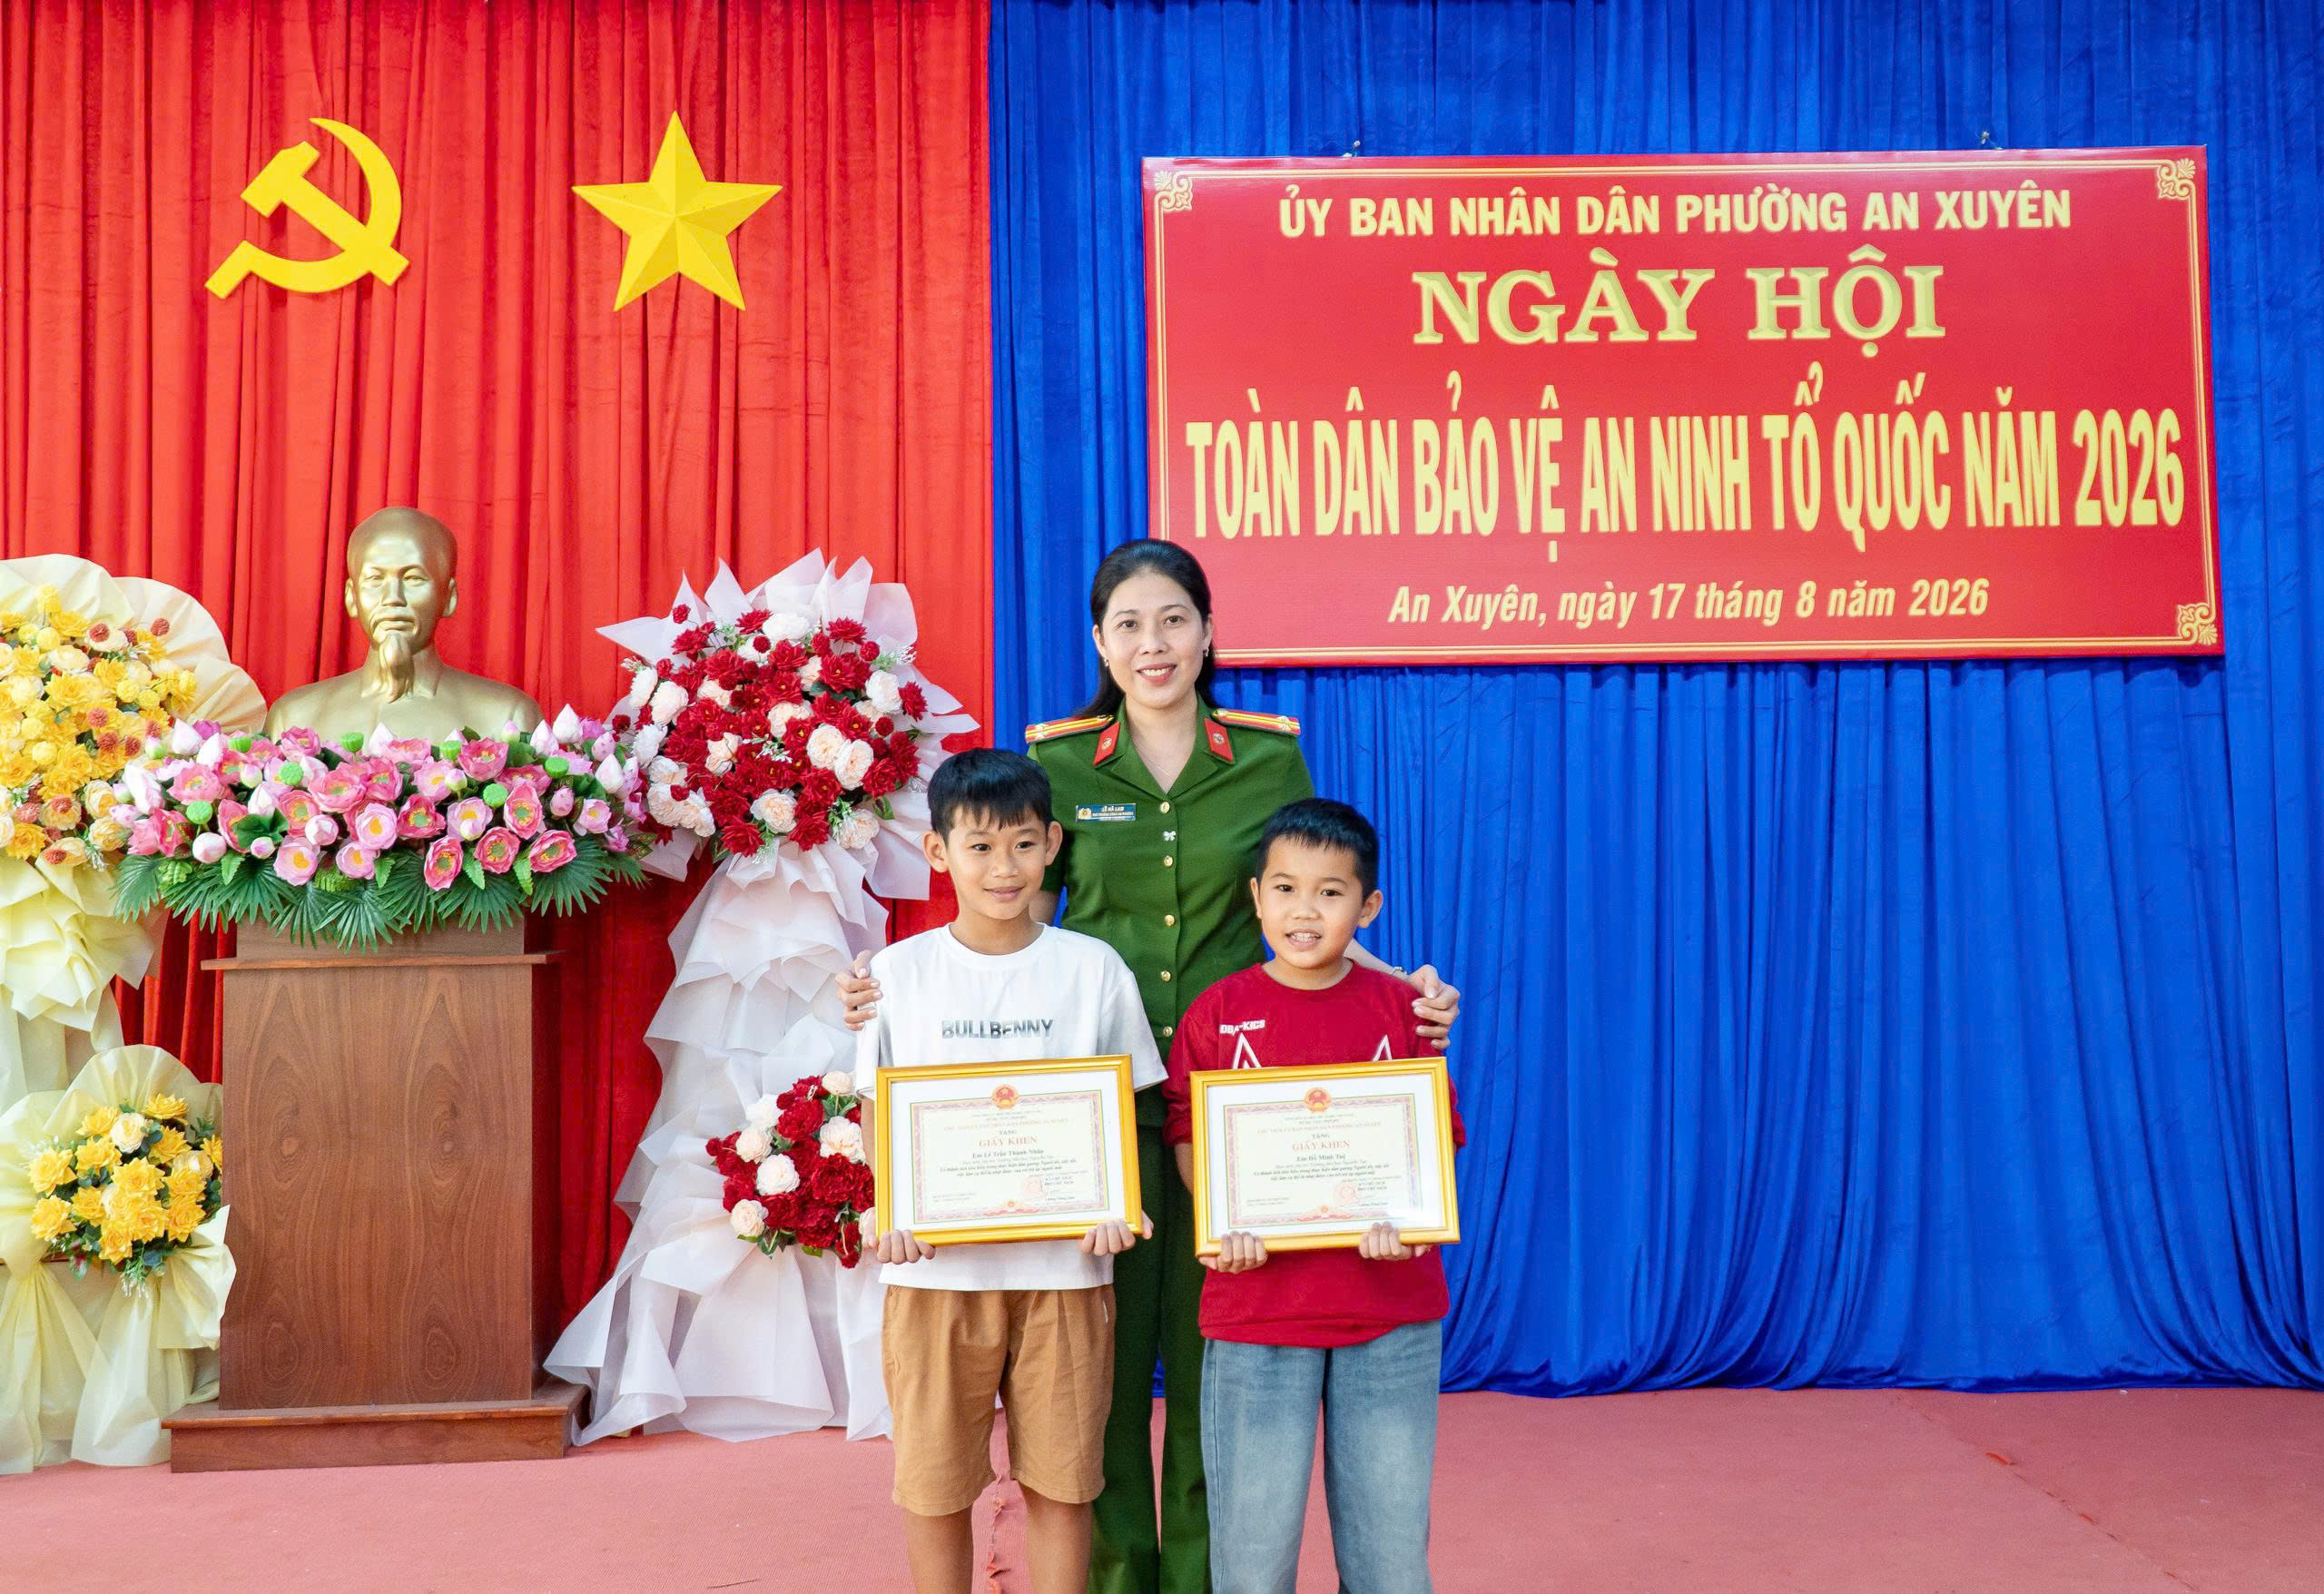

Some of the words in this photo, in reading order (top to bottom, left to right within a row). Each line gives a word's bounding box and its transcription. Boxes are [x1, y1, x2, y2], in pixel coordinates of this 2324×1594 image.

[1280, 184, 1333, 238] ỦY
[1350, 198, 1433, 236] BAN
[1450, 187, 1560, 235] NHÂN
[1577, 185, 1659, 234] DÂN
[1677, 183, 1846, 232] PHƯỜNG
[1863, 192, 1919, 231] AN
[1935, 179, 2070, 229] XUYÊN
[1413, 247, 1715, 344] NGÀY
[1746, 244, 1945, 358] HỘI
[1186, 389, 1300, 539] TOÀN
[1313, 387, 1400, 536] DÂN
[1413, 370, 1499, 536] BẢO
[1510, 385, 1565, 563] VỆ
[1581, 417, 1637, 533] AN
[1650, 416, 1751, 532] NINH
[1762, 361, 1823, 532] TỔ
[1833, 372, 1951, 552] QUỐC
[1963, 387, 2060, 526] NĂM
[2073, 408, 2183, 526] 2026
[1387, 586, 1431, 623] An
[1441, 584, 1546, 631] Xuyên,
[1558, 581, 1638, 629] ngày
[1649, 583, 1686, 619] 17
[1695, 581, 1783, 626] tháng
[1796, 581, 1817, 618] 8
[1827, 580, 1896, 617] năm
[1908, 578, 1989, 616] 2026
[941, 1018, 1053, 1038] BULLBENNY
[1008, 1136, 1037, 1146] KHEN
[1292, 1139, 1316, 1150] GIẤY
[1321, 1140, 1351, 1148] KHEN
